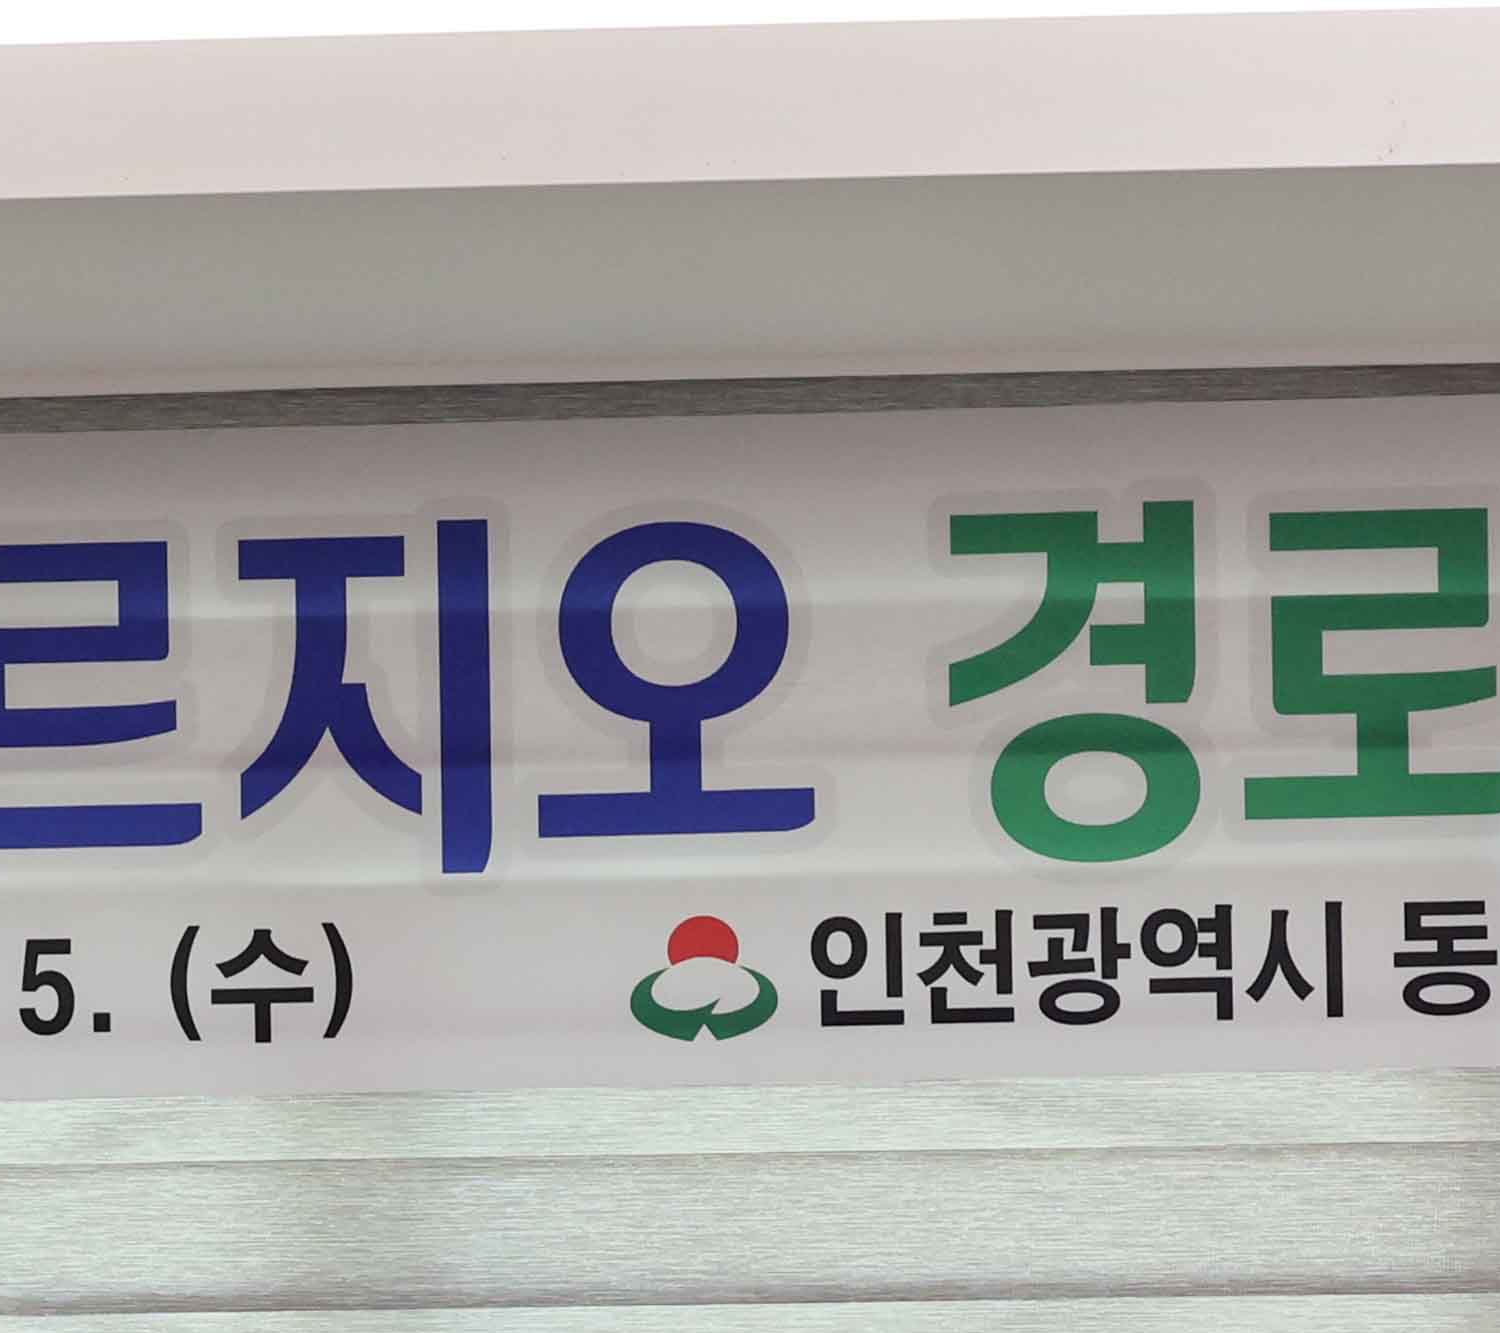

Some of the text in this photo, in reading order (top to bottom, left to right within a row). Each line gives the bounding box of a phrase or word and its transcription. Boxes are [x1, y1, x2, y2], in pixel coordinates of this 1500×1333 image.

[18, 937, 112, 1037] 5.
[168, 920, 355, 1045] (수)
[809, 900, 1345, 1028] 인천광역시
